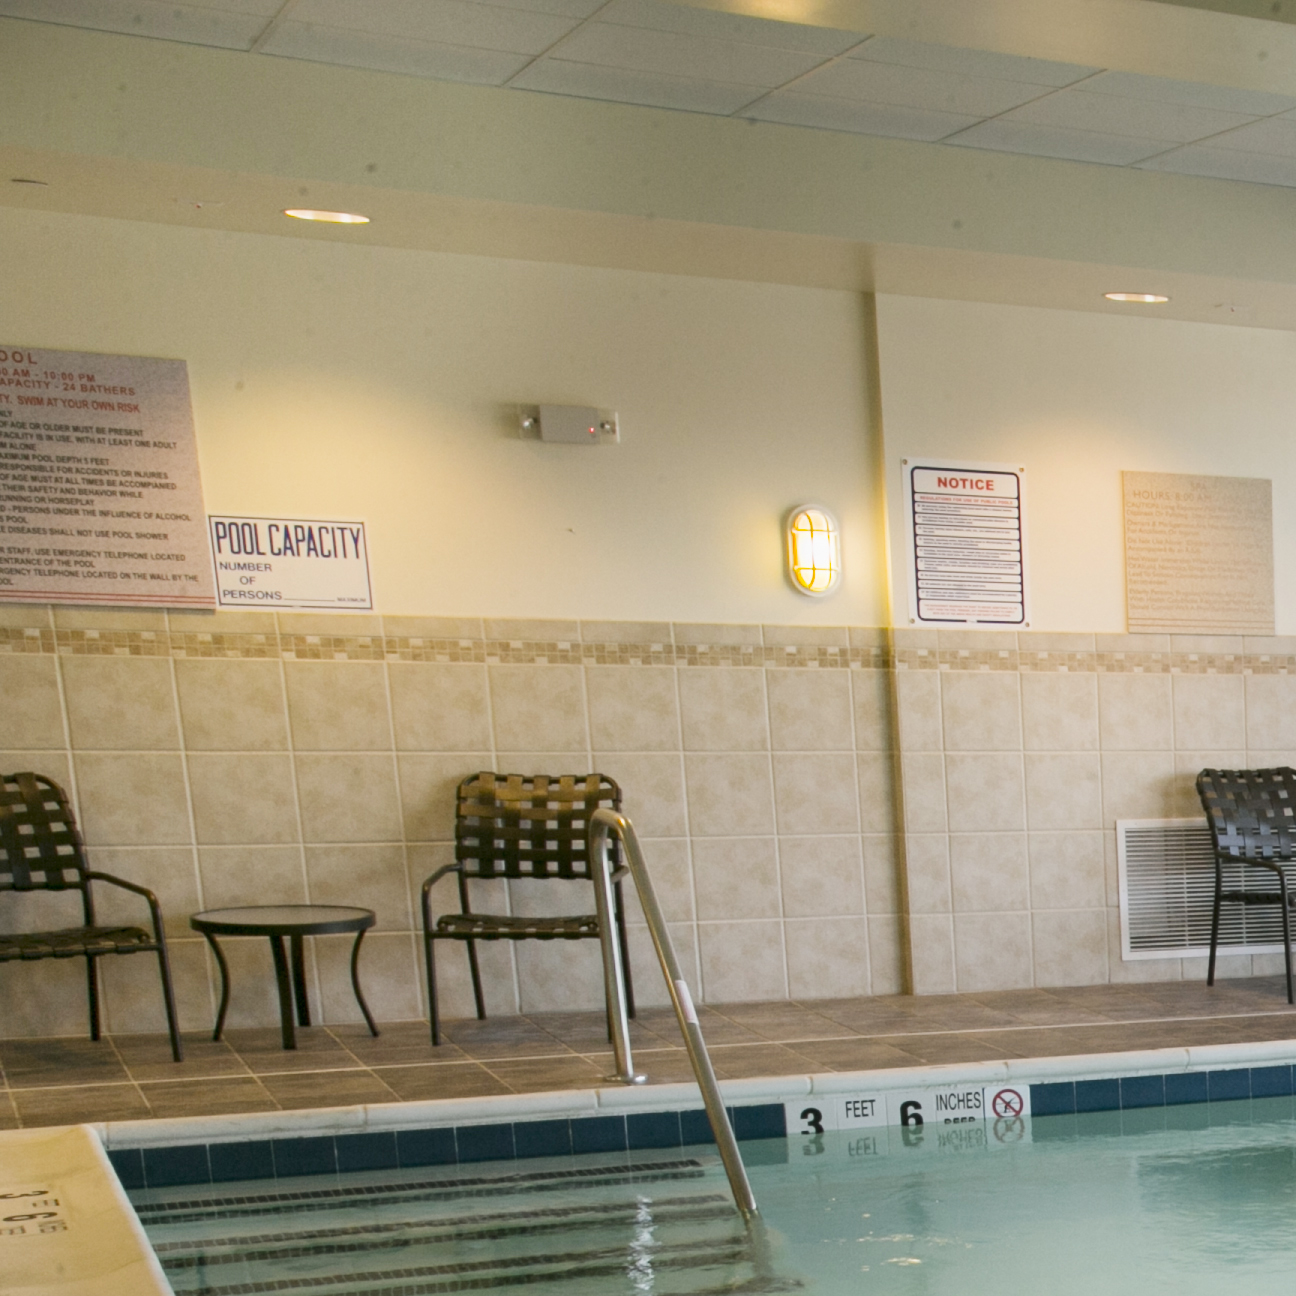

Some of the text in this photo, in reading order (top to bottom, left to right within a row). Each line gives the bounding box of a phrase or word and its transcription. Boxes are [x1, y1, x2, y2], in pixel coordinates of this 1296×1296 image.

[0, 350, 38, 365] OOL
[13, 368, 30, 378] AM
[44, 370, 74, 381] 10:00
[78, 373, 96, 382] PM
[0, 378, 136, 396] APACITY 24 BATHERS
[18, 396, 44, 406] SWIM
[46, 398, 58, 407] AT
[61, 399, 88, 410] YOUR
[92, 401, 114, 412] OWN
[118, 402, 140, 413] RISK
[10, 422, 28, 430] AGE
[30, 422, 40, 430] OR
[43, 424, 70, 432] OLDER
[96, 426, 106, 434] BE
[108, 428, 143, 436] PRESENT
[10, 443, 36, 452] ALONE
[75, 436, 94, 444] WITH
[108, 438, 132, 447] LEAST
[135, 440, 150, 448] ONE
[153, 440, 177, 450] ADULT
[32, 454, 109, 466] POOL DEPTH FEET
[56, 466, 72, 474] FOR
[76, 468, 118, 476] ACCIDENTS
[134, 470, 168, 480] INJURIES
[54, 476, 62, 484] AT
[82, 478, 104, 486] TIMES
[937, 476, 994, 492] NOTICE
[2, 484, 26, 492] THEIR
[28, 486, 58, 494] SAFETY
[78, 488, 117, 497] BEHAVIOR
[120, 490, 142, 498] WHILE
[48, 498, 94, 506] HORSEPLAY
[6, 516, 28, 524] POOL
[13, 506, 51, 514] PERSONS
[54, 508, 79, 516] UNDER
[99, 510, 141, 519] INFLUENCE
[156, 513, 191, 522] ALCOHOL
[8, 526, 47, 535] DISEASES
[49, 528, 74, 536] SHALL
[94, 530, 110, 538] USE
[136, 532, 168, 540] SHOWER
[214, 521, 360, 559] POOL CAPACITY
[34, 548, 51, 556] USE
[53, 548, 102, 558] EMERGENCY
[104, 552, 148, 560] TELEPHONE
[74, 560, 95, 568] POOL
[220, 561, 272, 572] NUMBER
[34, 568, 79, 577] TELEPHONE
[82, 571, 117, 579] LOCATED
[133, 572, 148, 580] THE
[184, 574, 198, 582] THE
[239, 576, 256, 586] OF
[223, 589, 282, 600] PERSONS
[800, 1092, 982, 1134] 3 FEET 6 INCHES
